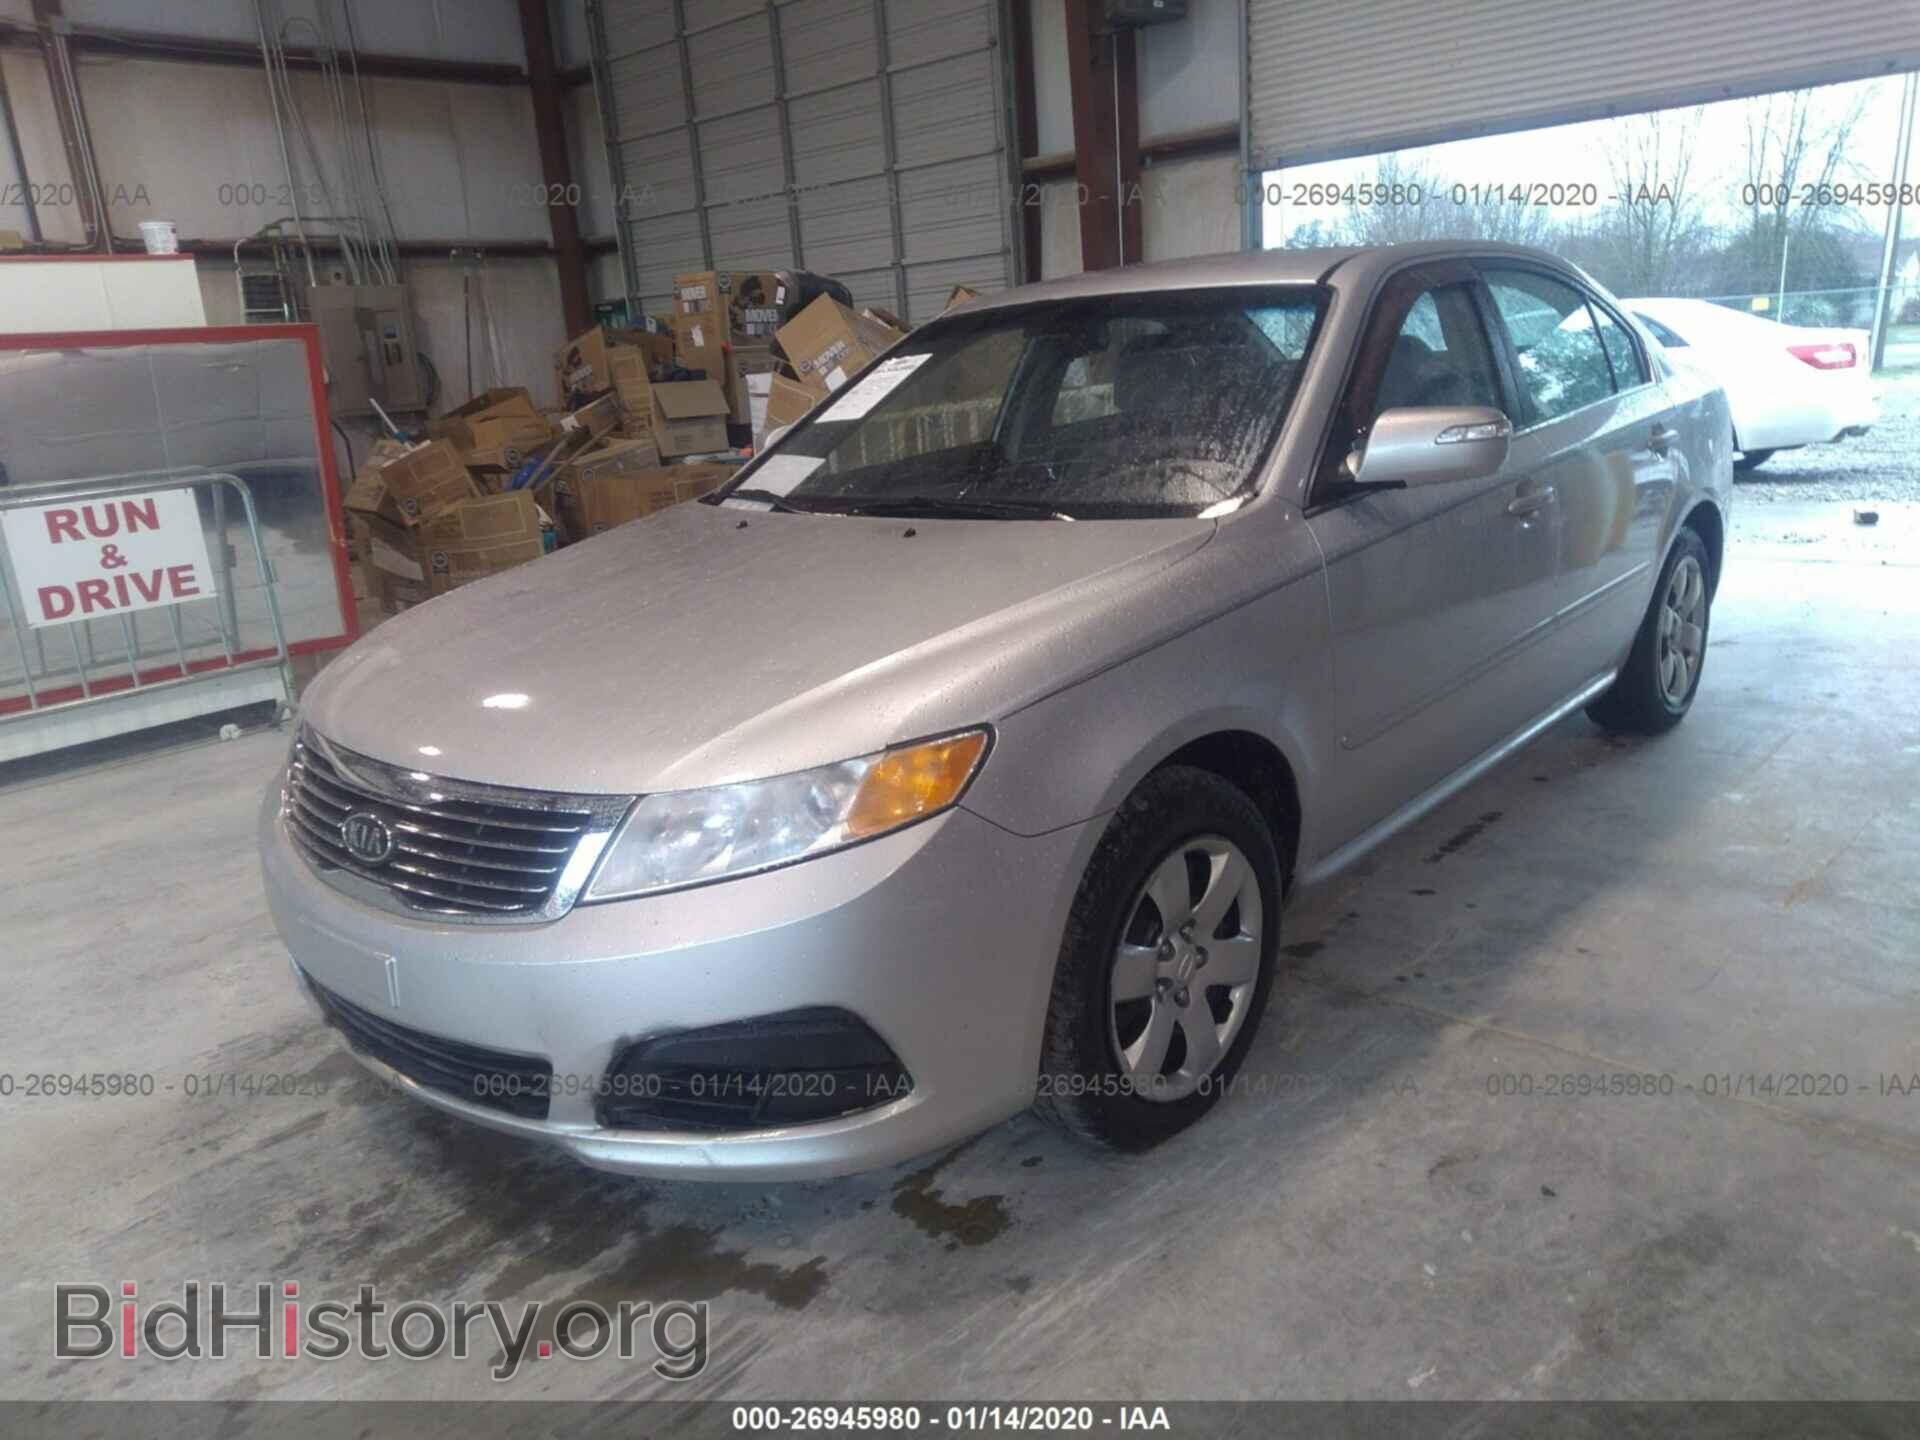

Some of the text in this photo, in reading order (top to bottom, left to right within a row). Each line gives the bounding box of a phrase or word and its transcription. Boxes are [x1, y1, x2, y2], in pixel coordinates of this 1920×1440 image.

[43, 498, 160, 544] RUN
[100, 543, 128, 569] &
[37, 564, 200, 621] DRIVE
[349, 820, 381, 855] KIA
